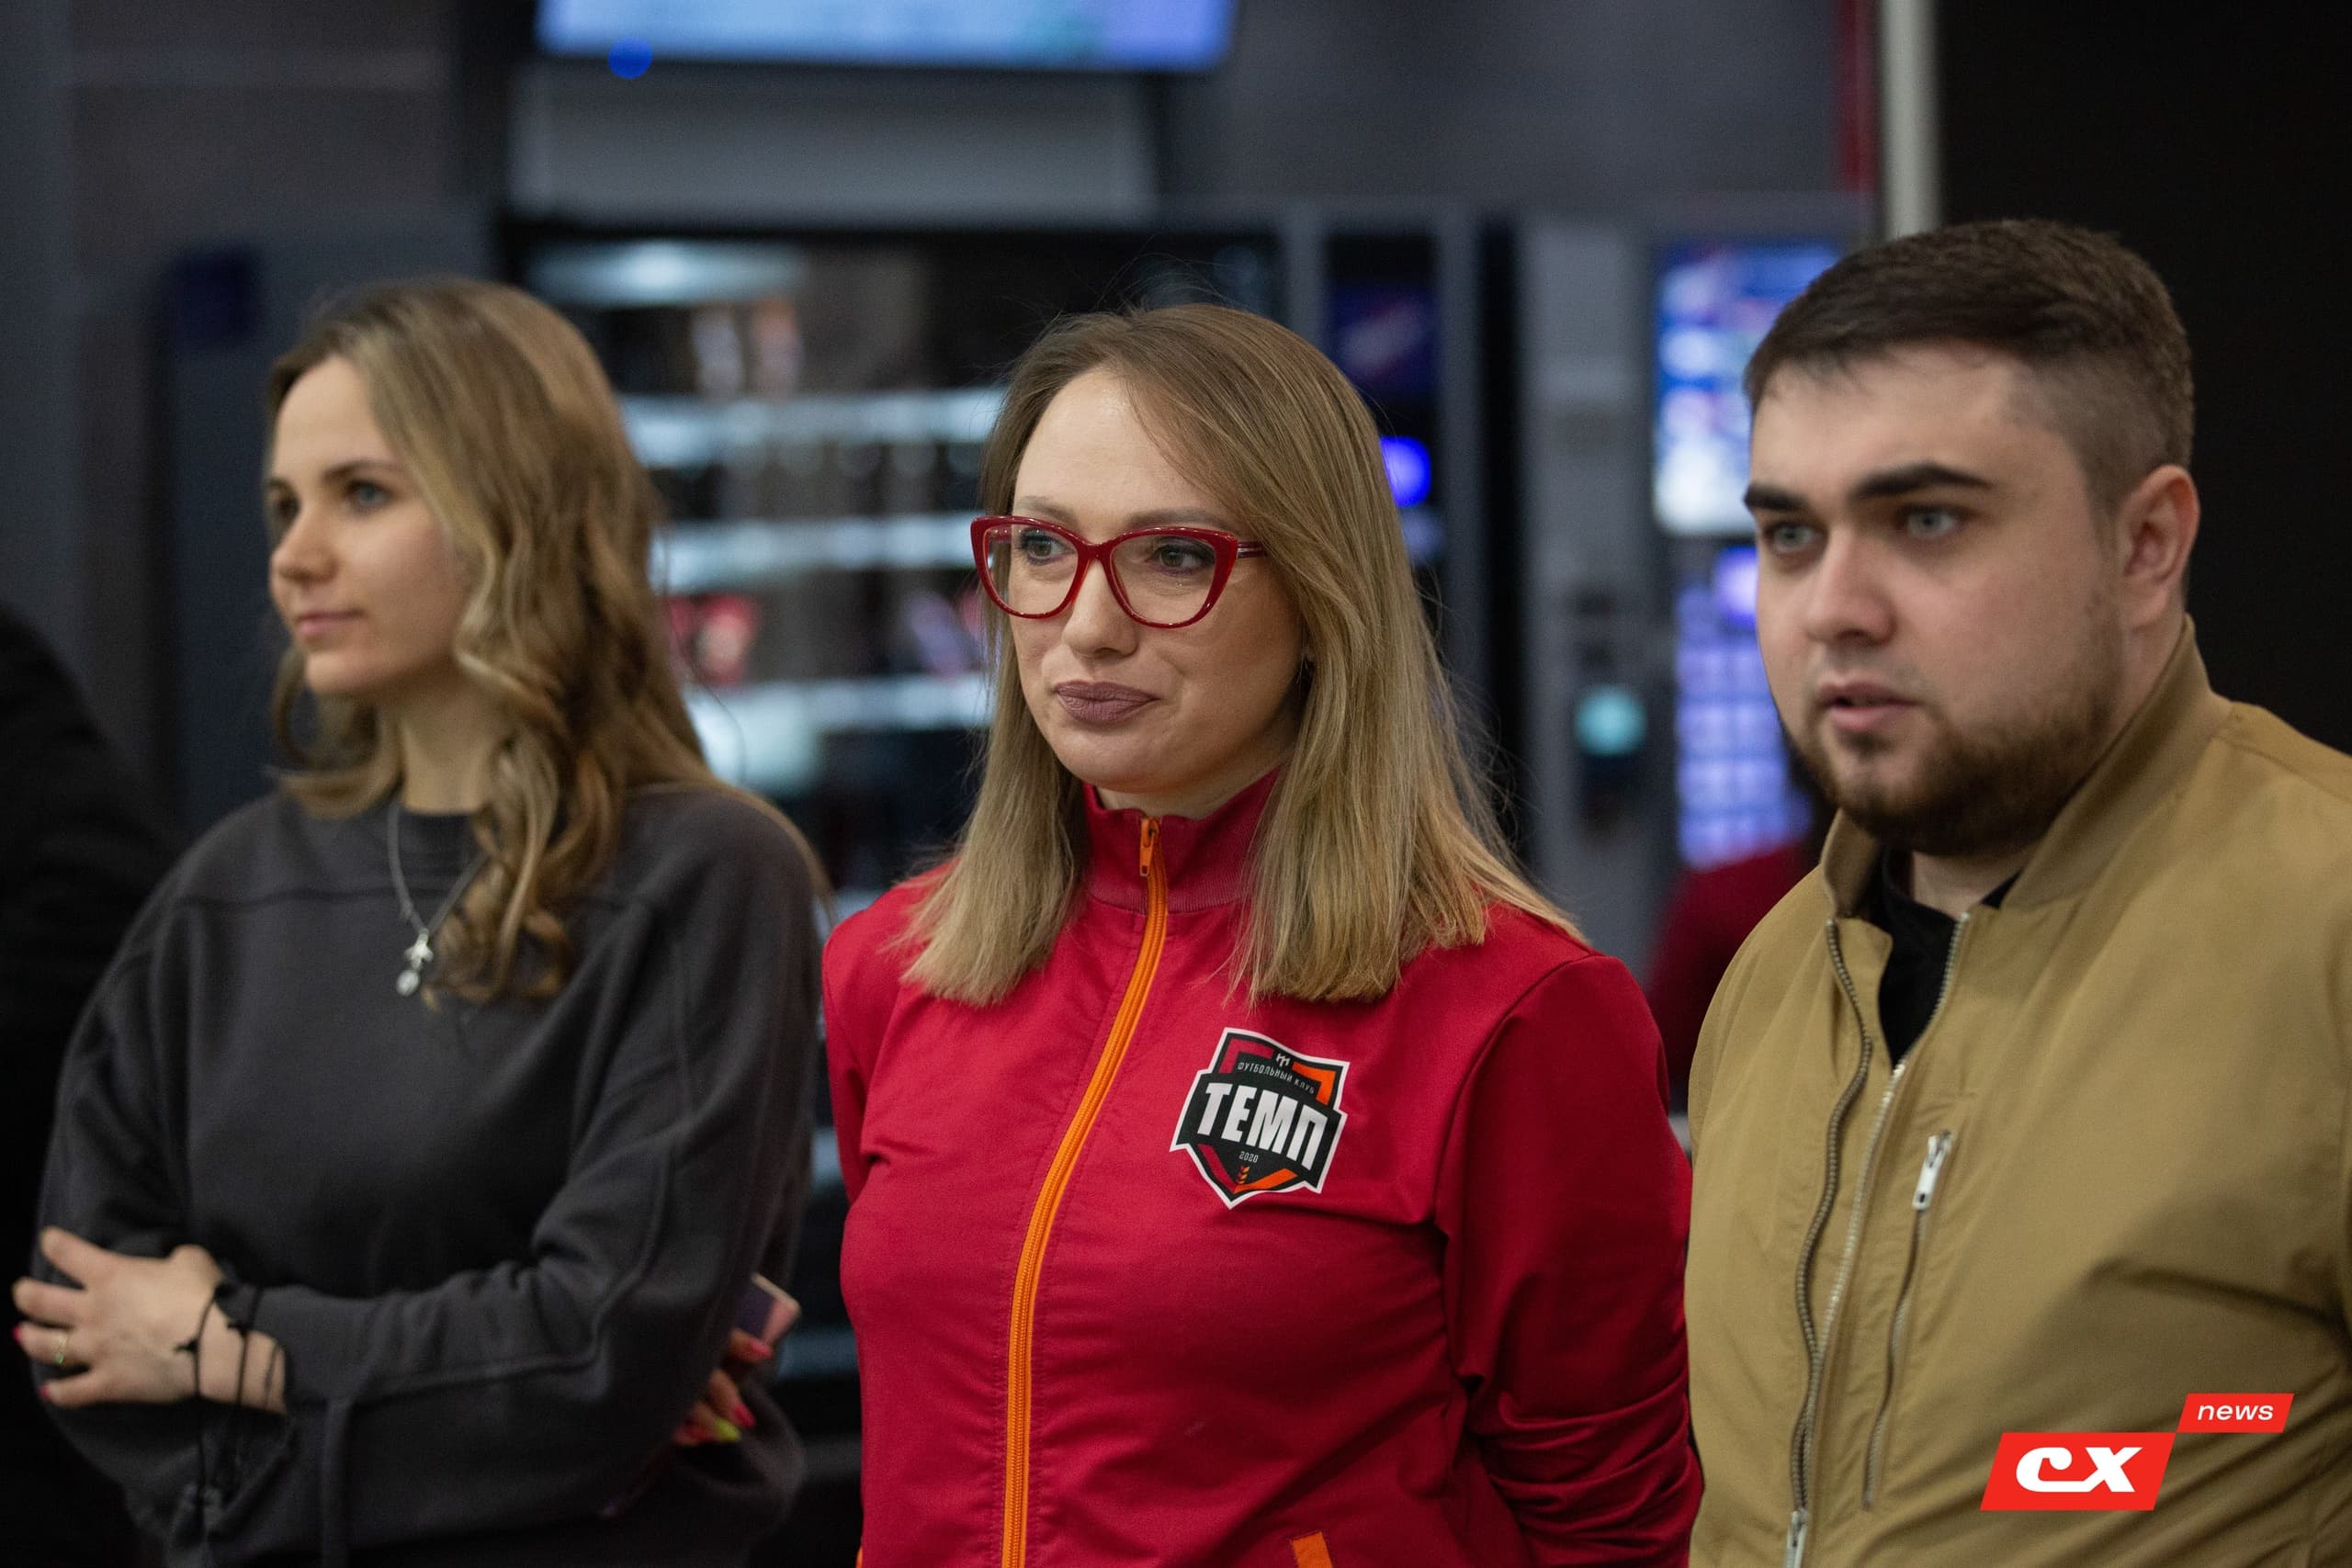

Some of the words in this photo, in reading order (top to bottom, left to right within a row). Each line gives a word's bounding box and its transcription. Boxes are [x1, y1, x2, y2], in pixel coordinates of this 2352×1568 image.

[1294, 1077, 1315, 1095] КЛУБ
[1197, 1082, 1329, 1171] ТЕМП
[1238, 1150, 1259, 1163] 2020
